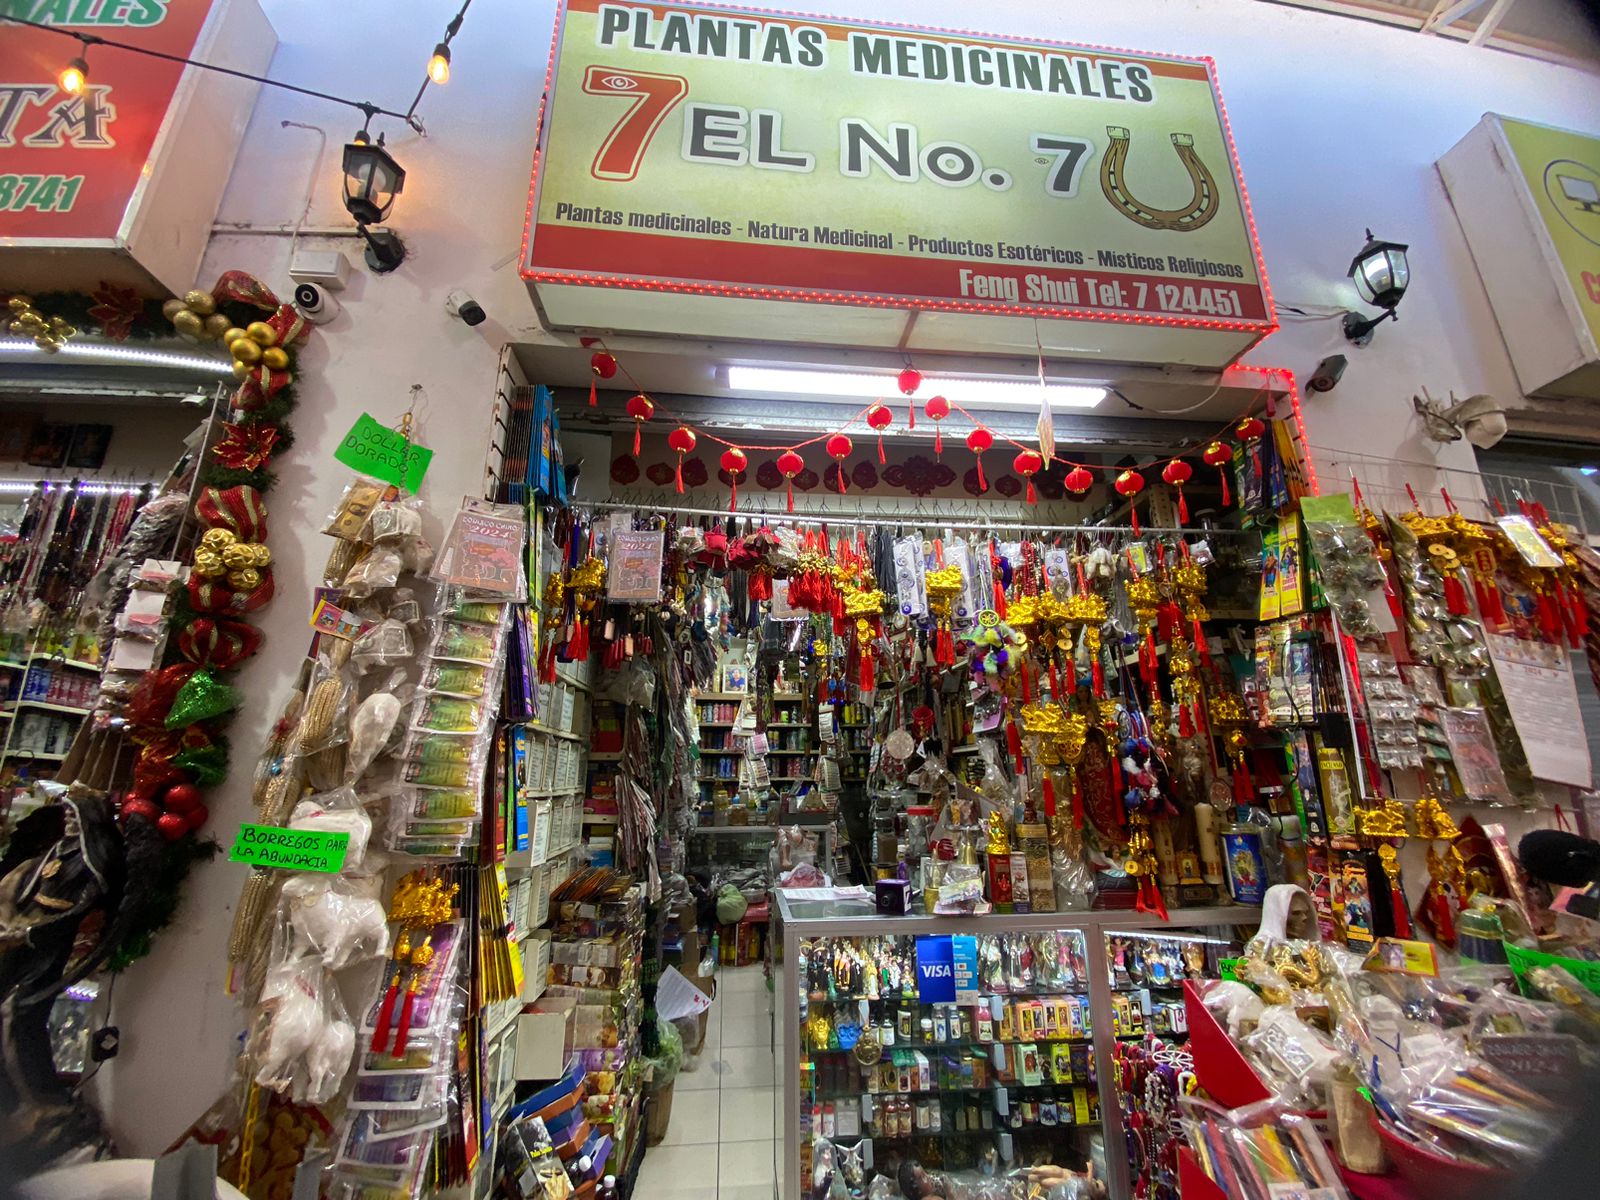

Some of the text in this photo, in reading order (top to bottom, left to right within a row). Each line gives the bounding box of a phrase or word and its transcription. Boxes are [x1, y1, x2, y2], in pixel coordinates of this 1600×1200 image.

[600, 8, 1154, 103] PLANTAS MEDICINALES
[582, 65, 689, 182] 7
[684, 103, 1092, 196] EL No. 7
[555, 202, 623, 226] Plantas
[628, 211, 732, 236] medicinales
[747, 220, 809, 243] Natura
[813, 226, 894, 250] Medicinal
[908, 234, 994, 258] Productos
[997, 241, 1084, 265] Esotéricos
[1168, 256, 1244, 279] Religiosos
[959, 268, 1244, 318] Feng Shui Tel: 7 124451
[345, 435, 409, 474] DORADO
[361, 425, 421, 466] DOLLAR
[236, 846, 328, 869] LA ABUNDACIA
[243, 827, 321, 851] BORREGOS
[920, 964, 952, 978] VISA
